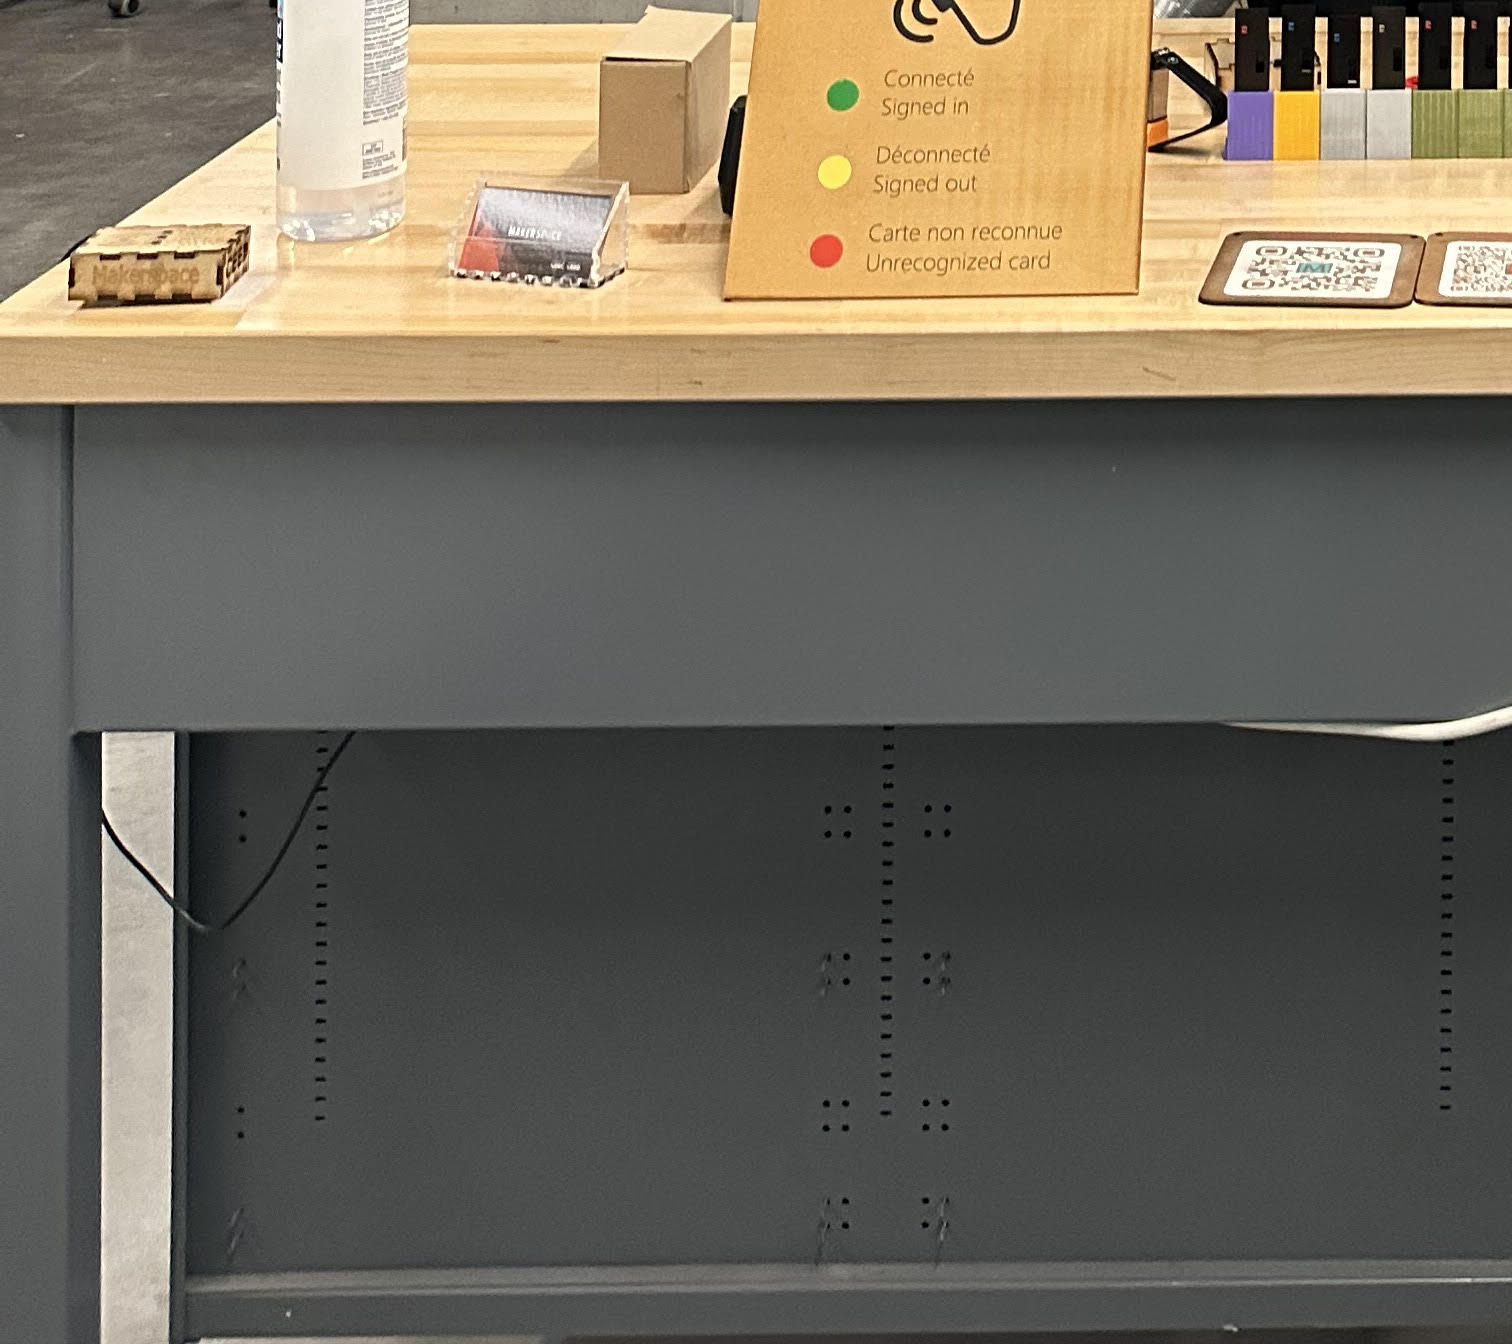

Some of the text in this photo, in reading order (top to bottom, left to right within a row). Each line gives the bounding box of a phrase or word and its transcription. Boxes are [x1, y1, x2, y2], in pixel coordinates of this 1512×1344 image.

[884, 69, 975, 89] Connecté
[881, 98, 970, 121] Signed in
[876, 145, 991, 164] Déconnecté
[873, 174, 977, 198] Signed out
[868, 224, 1063, 243] Carte non reconnue
[866, 252, 1051, 277] Unrecognized card
